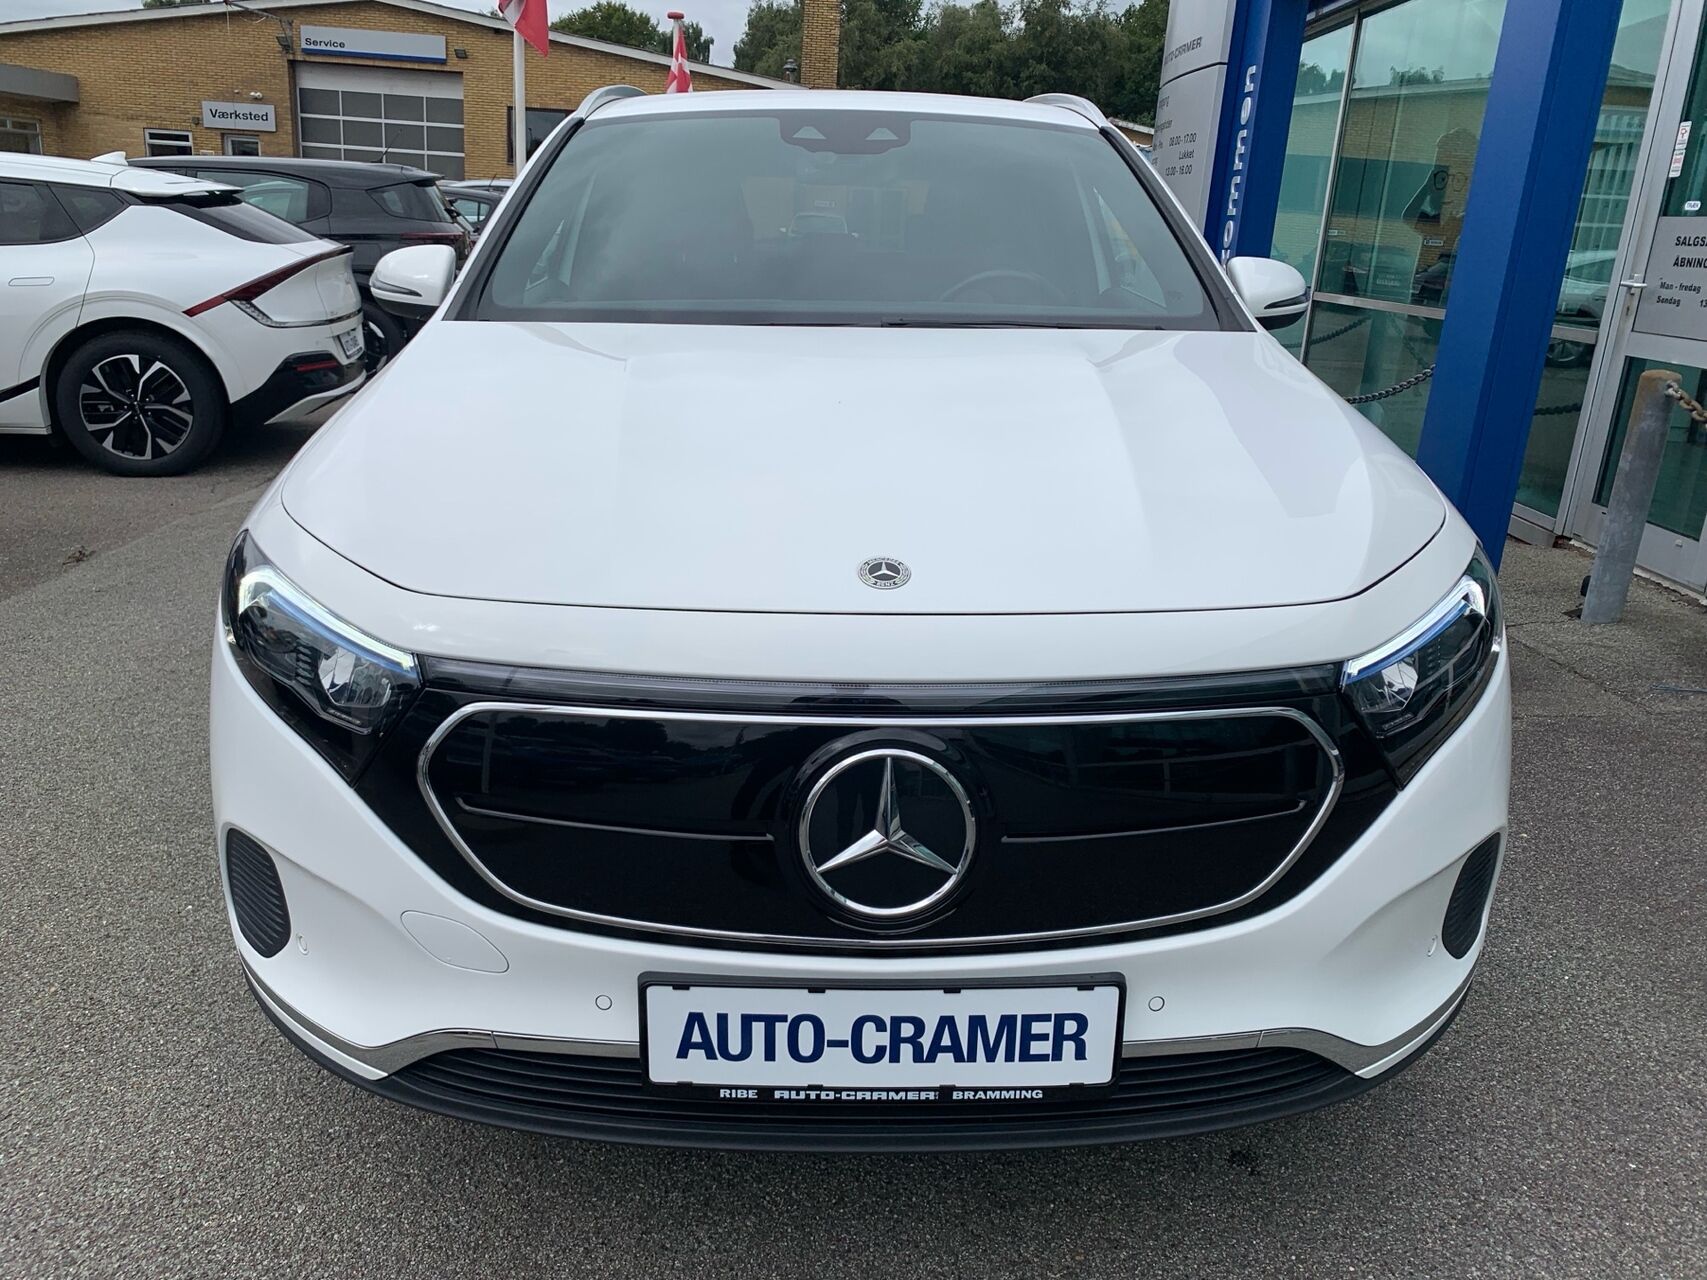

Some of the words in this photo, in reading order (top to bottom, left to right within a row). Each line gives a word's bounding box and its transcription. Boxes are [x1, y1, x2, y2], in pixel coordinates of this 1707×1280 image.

[305, 37, 346, 49] Service
[209, 108, 269, 122] Værksted
[1675, 235, 1707, 247] SALGS
[1660, 281, 1674, 290] Man
[1679, 282, 1701, 294] fredag
[675, 1011, 1089, 1064] AUTO-CRAMER
[719, 1088, 758, 1098] RIBE
[774, 1089, 935, 1100] AUTO-CRAMER
[952, 1089, 1043, 1100] BRAMMING
